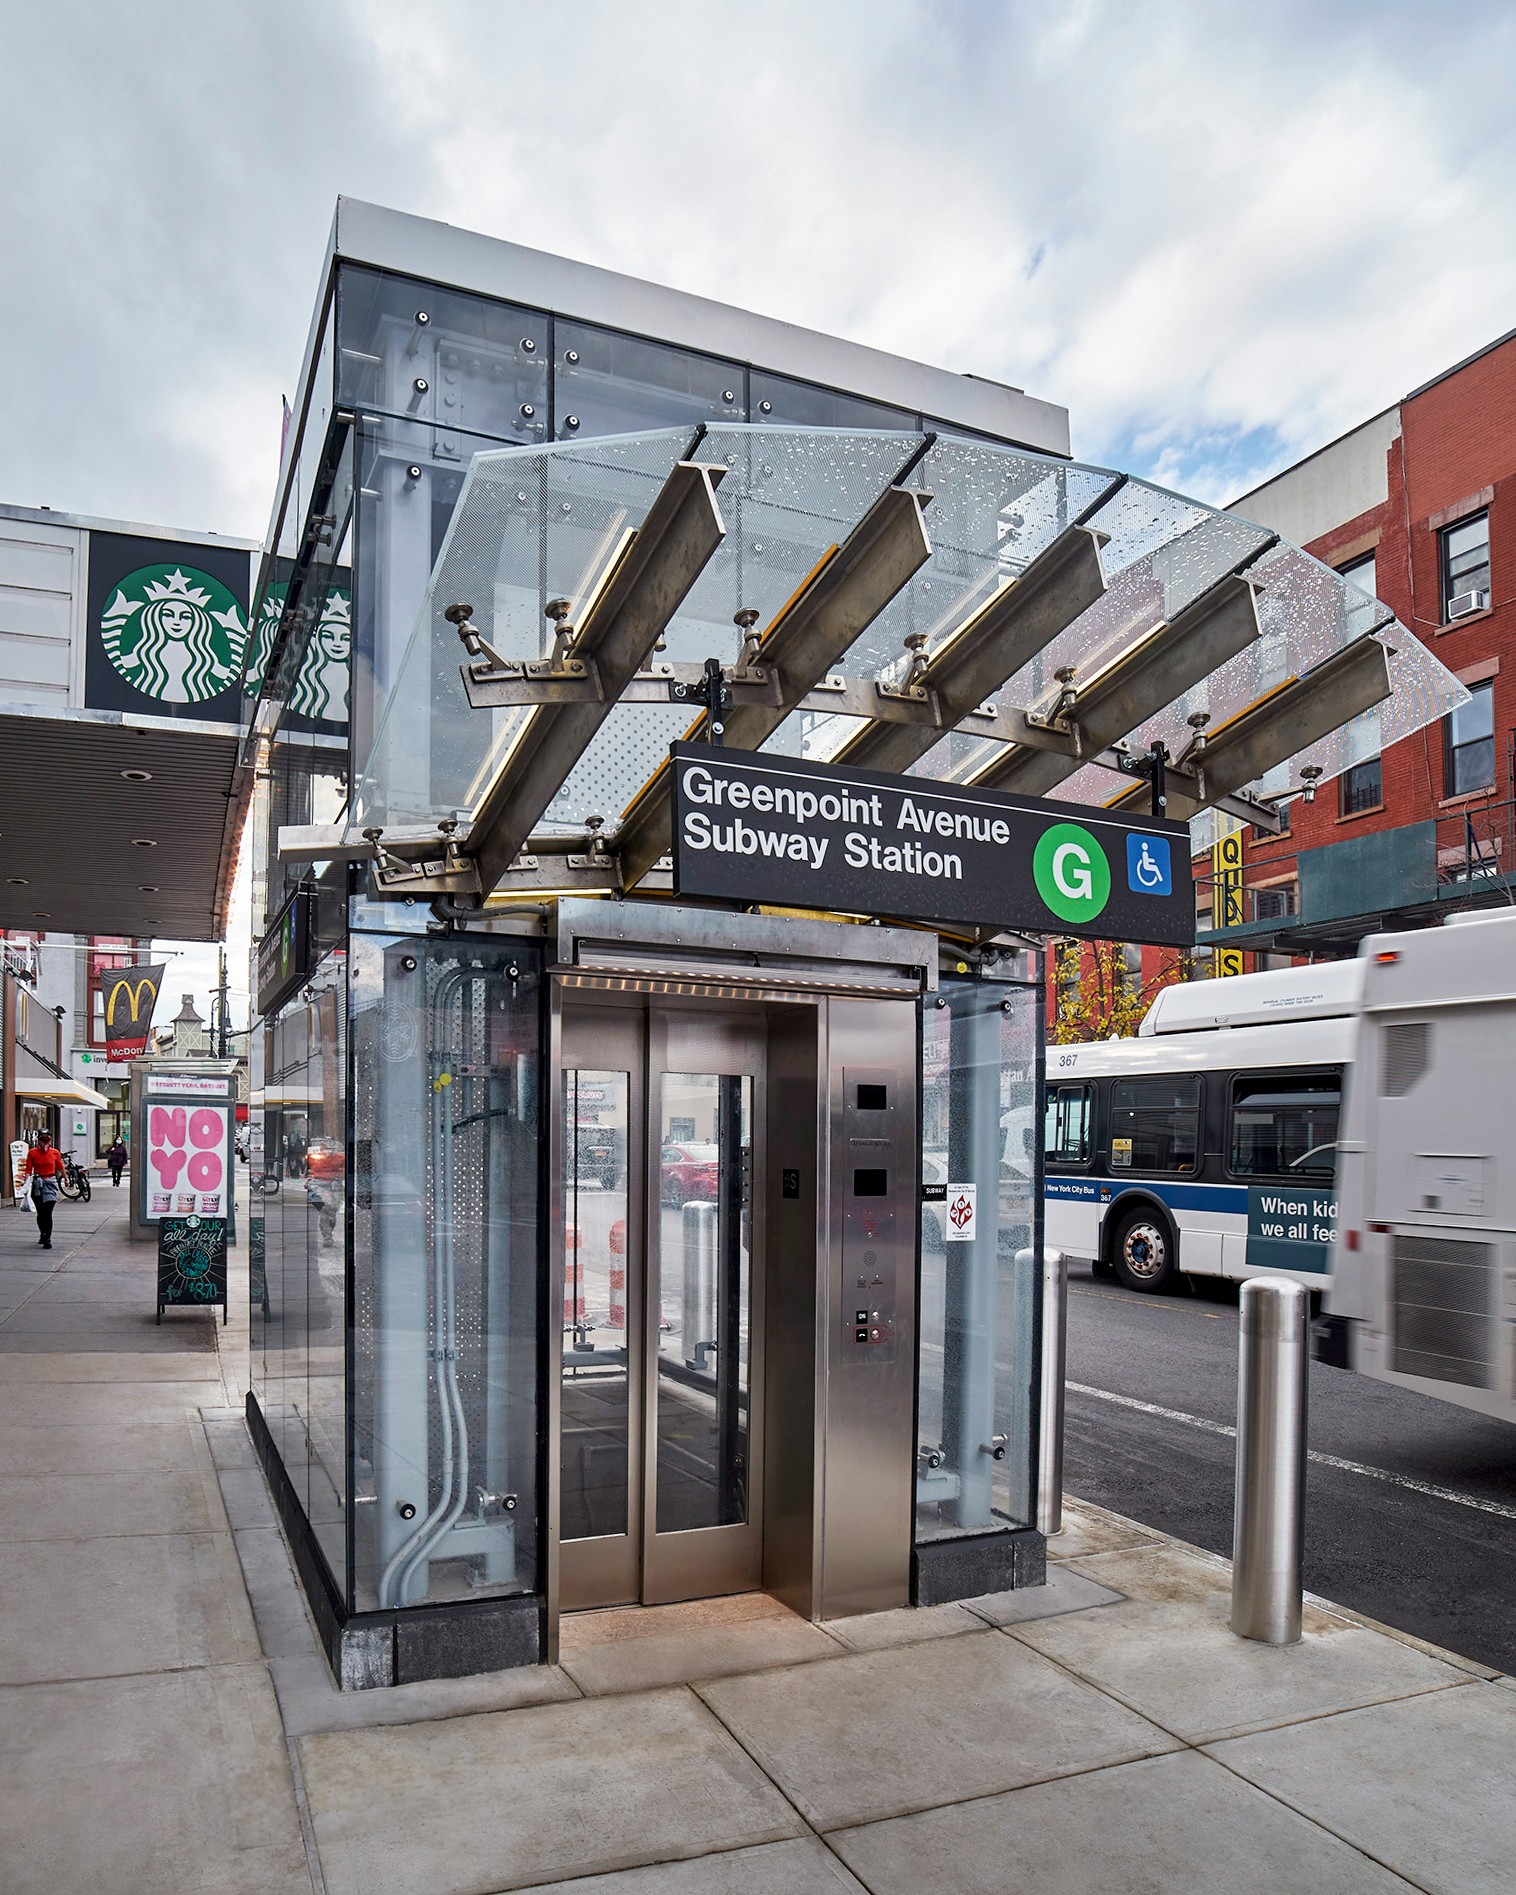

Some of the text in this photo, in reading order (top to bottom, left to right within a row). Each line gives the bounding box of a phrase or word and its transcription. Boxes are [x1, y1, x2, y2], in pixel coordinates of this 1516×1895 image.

[682, 766, 1011, 844] Greenpoint Avenue
[683, 812, 963, 881] Subway Station
[1052, 843, 1093, 900] G
[1059, 1055, 1078, 1067] 367
[150, 1107, 224, 1150] NO
[150, 1149, 223, 1191] YO
[1059, 1185, 1071, 1193] York
[1071, 1186, 1082, 1194] City
[1083, 1187, 1095, 1195] Bus
[1100, 1194, 1112, 1202] 367
[1261, 1196, 1308, 1216] When
[163, 1229, 187, 1241] all
[164, 1221, 222, 1232] GET OUR
[1261, 1223, 1285, 1237] we
[1288, 1223, 1308, 1240] all
